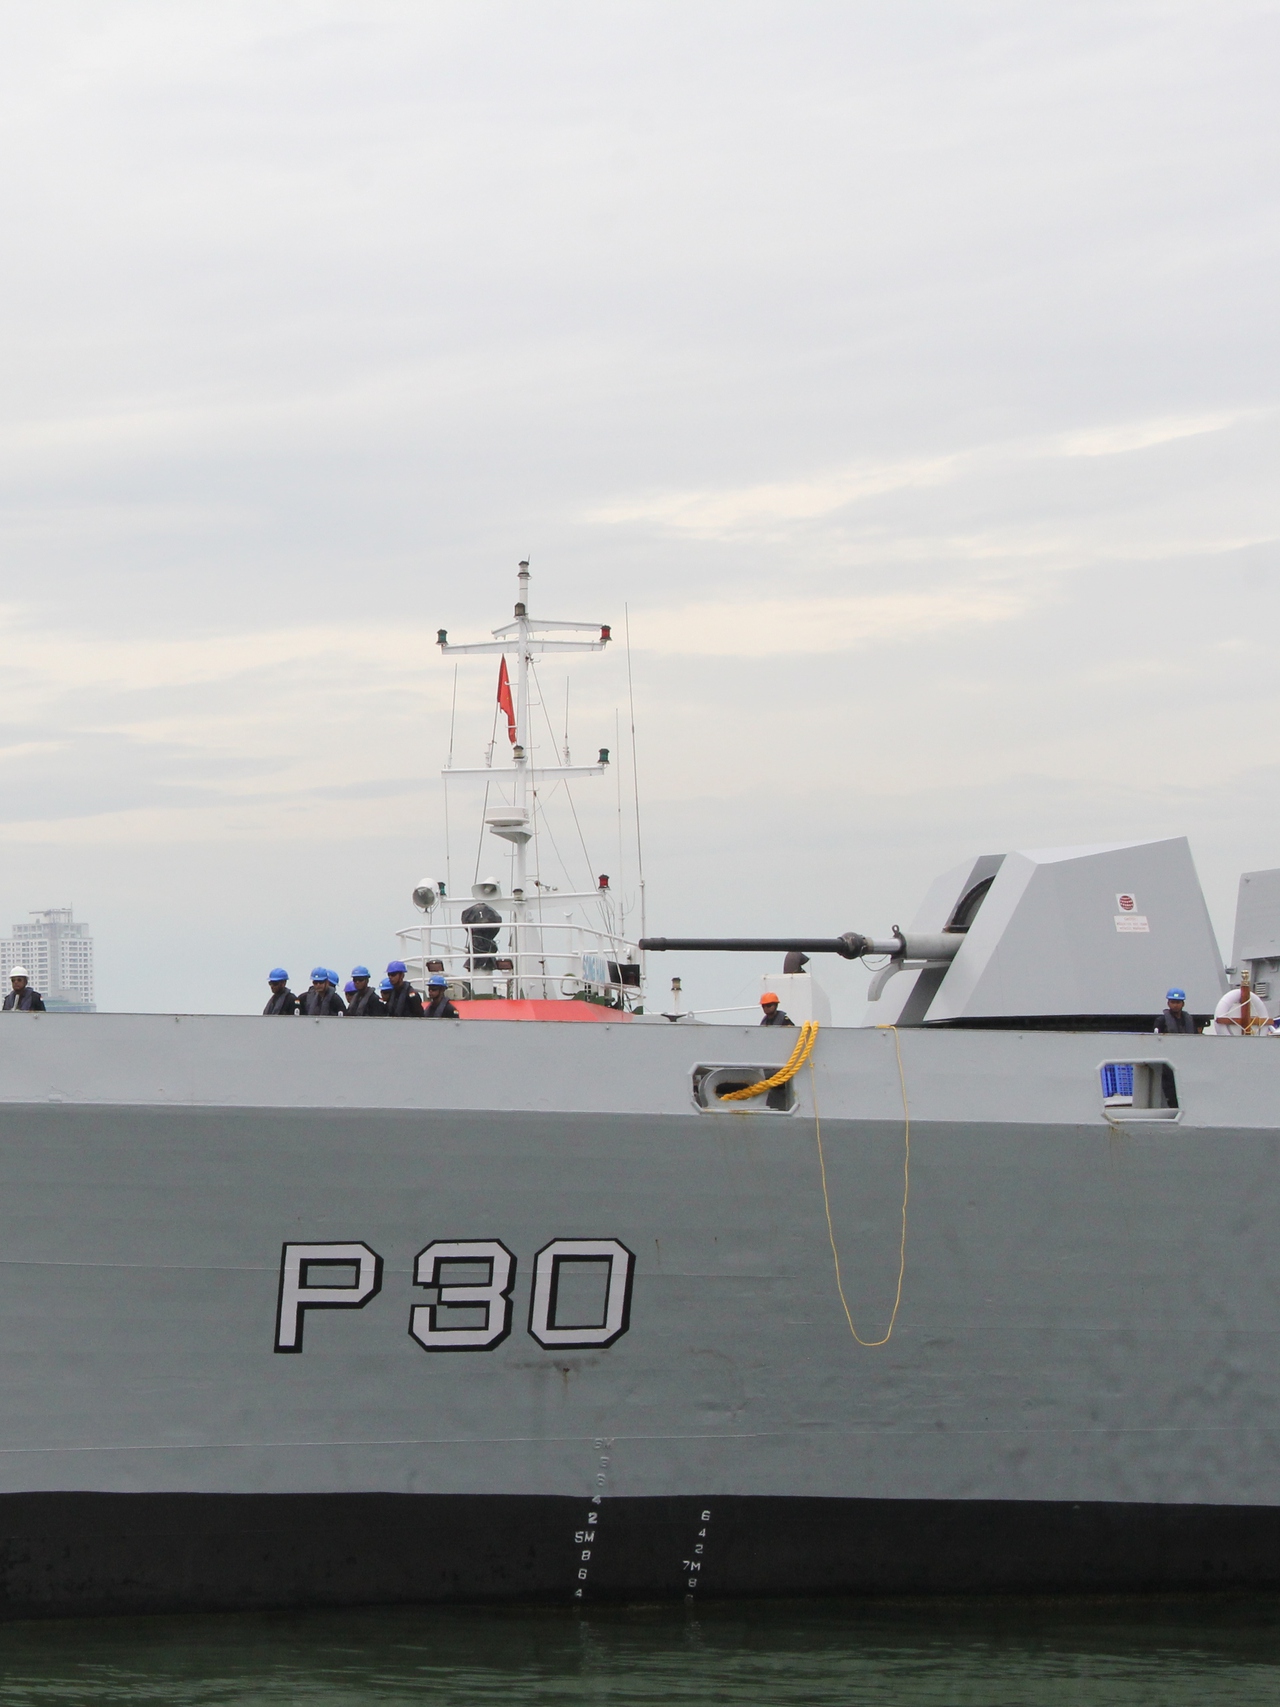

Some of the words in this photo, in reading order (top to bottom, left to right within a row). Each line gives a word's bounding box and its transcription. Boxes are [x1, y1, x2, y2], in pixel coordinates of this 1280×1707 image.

[587, 1511, 598, 1524] 2
[700, 1509, 711, 1521] 6
[574, 1530, 596, 1543] 5M
[698, 1527, 707, 1538] 4
[694, 1543, 704, 1554] 2
[581, 1550, 591, 1561] 8
[682, 1560, 701, 1571] 7M
[577, 1568, 588, 1580] 6
[688, 1577, 698, 1588] 8
[574, 1588, 583, 1598] 4
